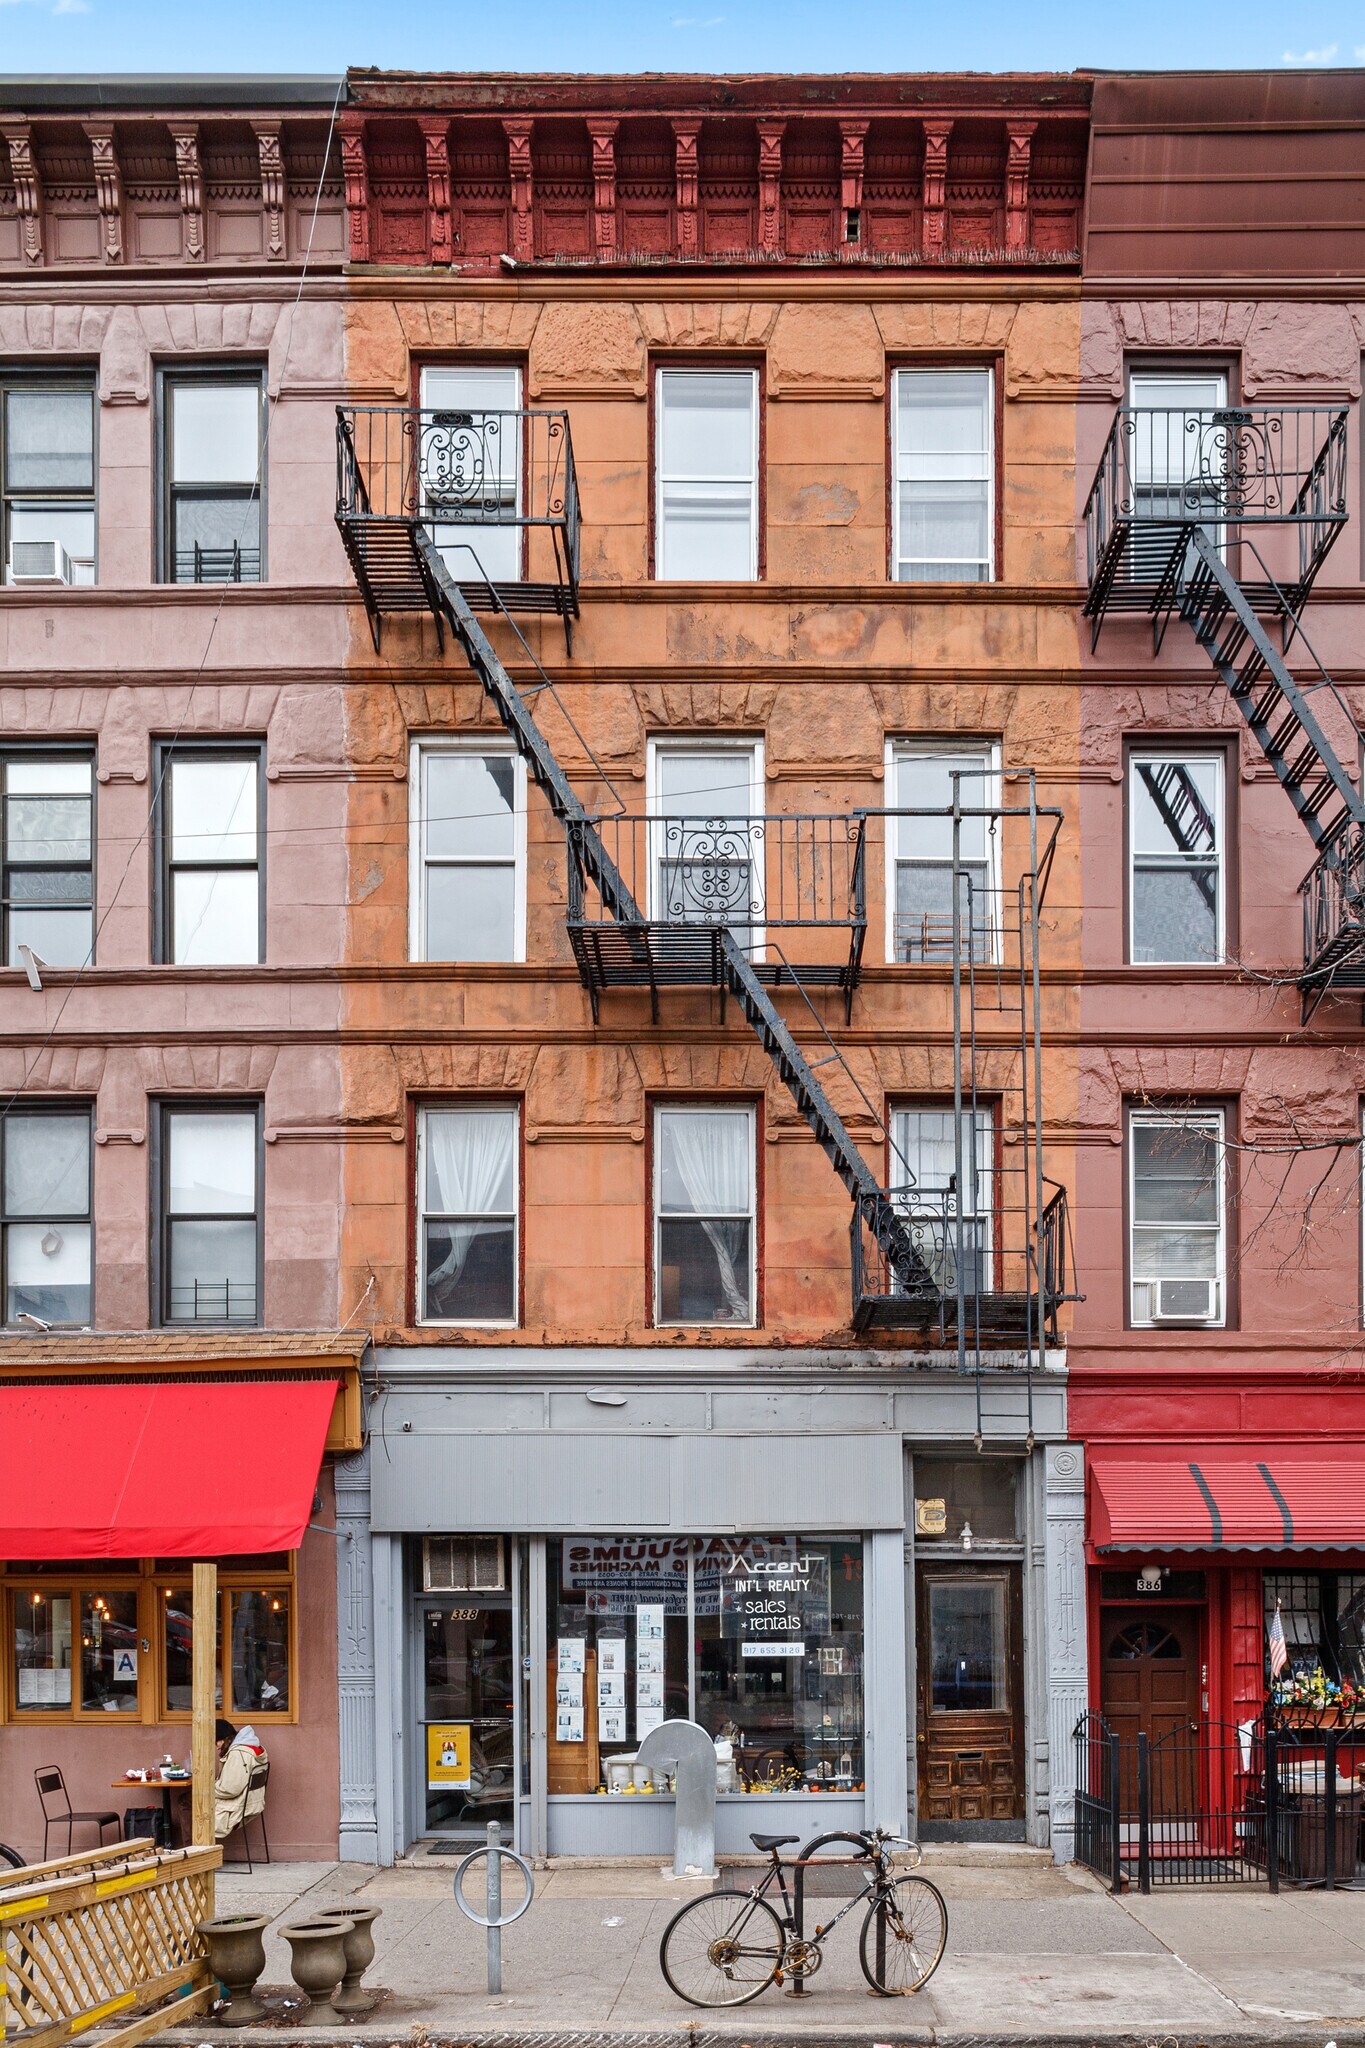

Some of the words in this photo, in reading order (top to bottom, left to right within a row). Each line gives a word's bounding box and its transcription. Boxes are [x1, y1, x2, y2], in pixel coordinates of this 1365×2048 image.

[728, 1553, 824, 1574] Accent
[735, 1579, 762, 1592] INT'L
[768, 1579, 810, 1592] REALTY
[1138, 1580, 1160, 1590] 386
[745, 1599, 787, 1614] sales
[452, 1608, 478, 1620] 388
[749, 1615, 802, 1631] rentals
[743, 1647, 757, 1655] 917
[760, 1647, 776, 1655] 655
[117, 1653, 135, 1672] A
